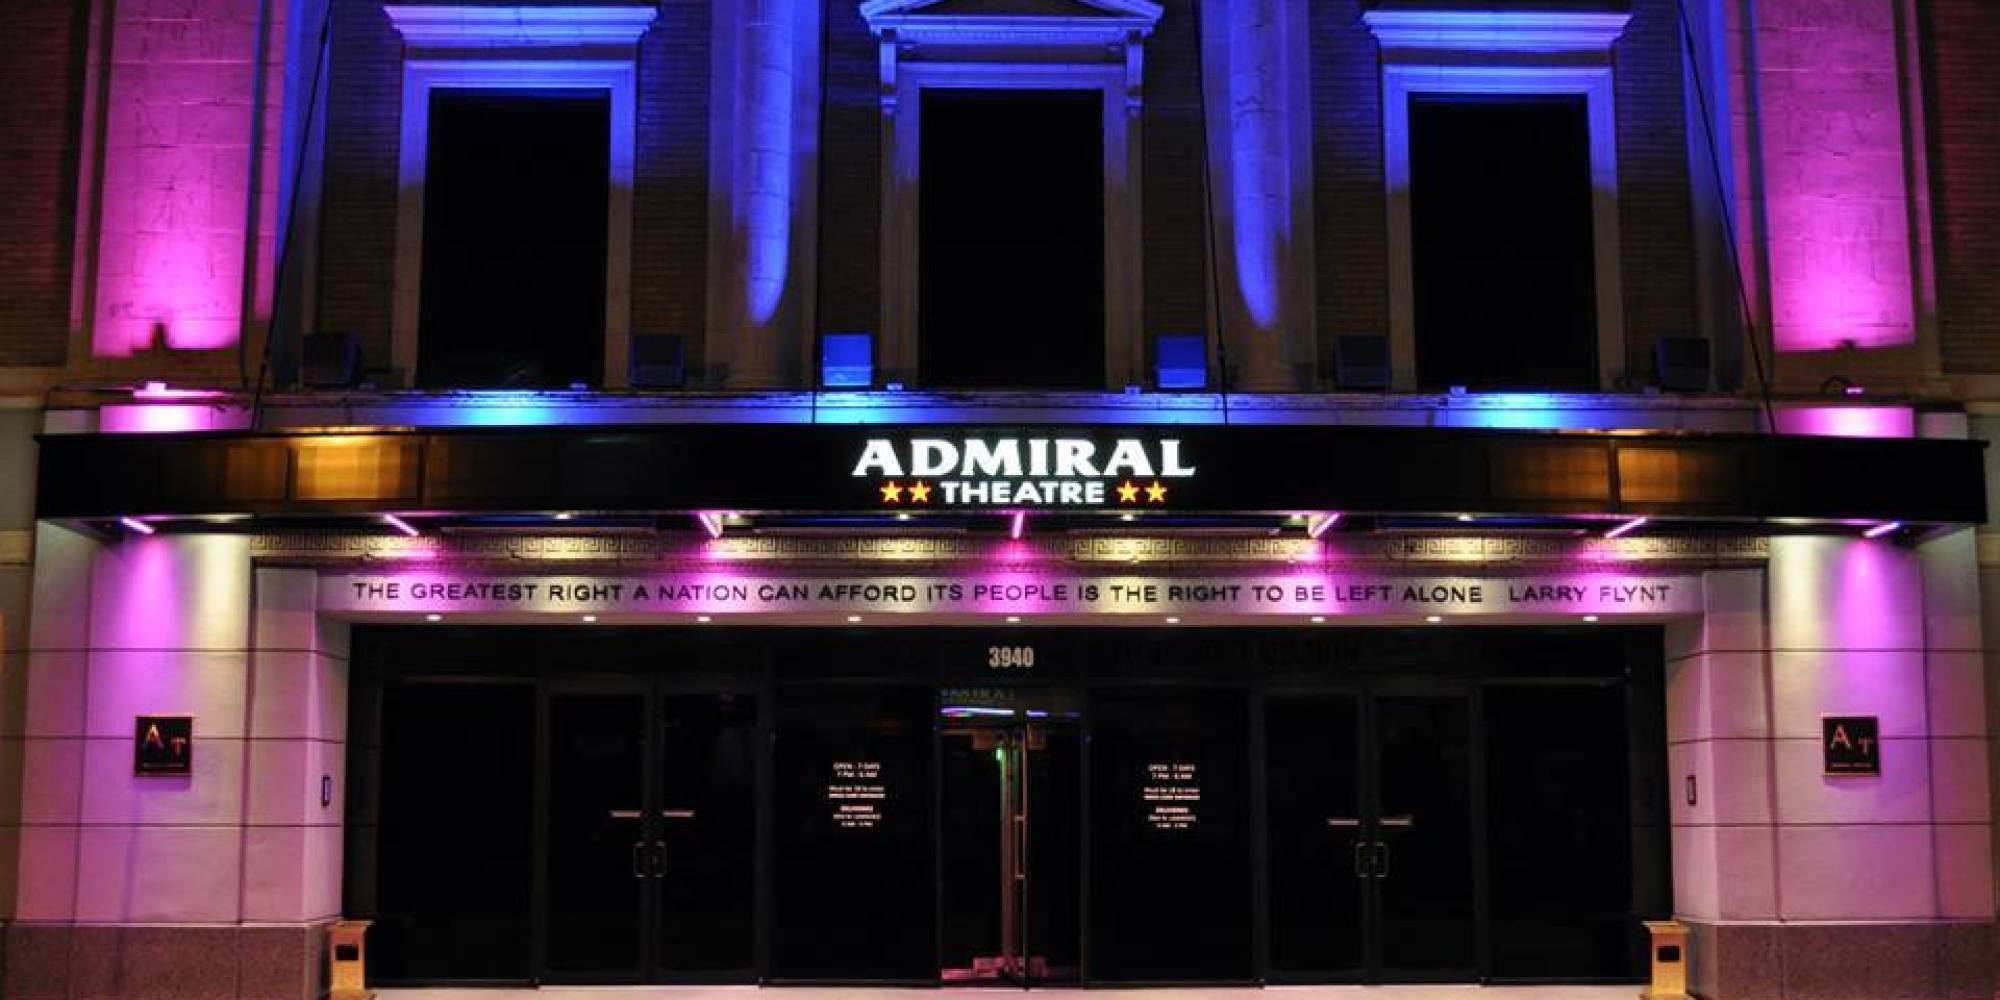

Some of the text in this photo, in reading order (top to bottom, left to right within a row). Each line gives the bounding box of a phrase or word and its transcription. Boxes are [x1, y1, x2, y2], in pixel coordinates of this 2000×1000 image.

[852, 439, 1195, 477] ADMIRAL
[940, 481, 1105, 504] THEATRE
[353, 583, 1670, 602] THE GREATEST RIGHT A NATION CAN AFFORD ITS PEOPLE IS THE RIGHT TO BE LEFT ALONE LARRY FLYNT
[988, 646, 1035, 669] 3940
